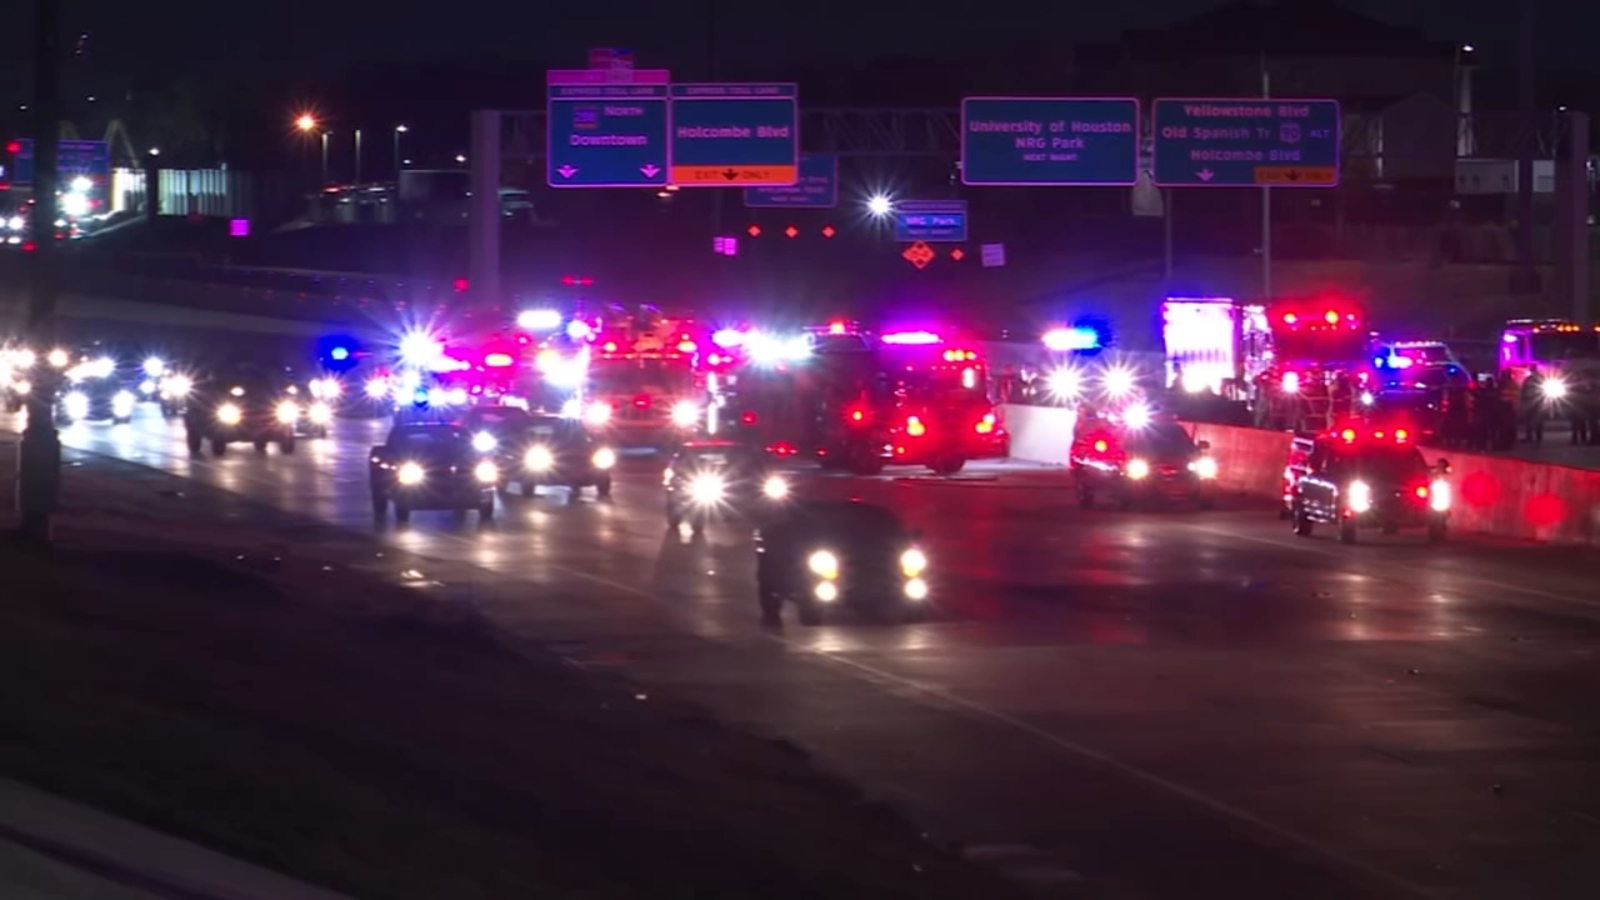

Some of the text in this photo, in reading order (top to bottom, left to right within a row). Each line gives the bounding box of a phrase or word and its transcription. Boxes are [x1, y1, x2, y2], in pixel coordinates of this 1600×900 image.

[1184, 105, 1310, 117] Yellowstone Blvd
[677, 126, 789, 138] Holcombe Blvd
[969, 120, 1131, 135] University of Houston
[1162, 127, 1187, 138] Old
[1193, 127, 1250, 140] Spanish
[1256, 128, 1271, 138] Tr
[1309, 129, 1330, 138] ALT
[569, 134, 648, 146] Downtown
[1015, 137, 1085, 149] NRG Park
[1190, 149, 1301, 160] Holcombe Blvd
[694, 170, 770, 180] EXIT ONLY
[933, 216, 957, 226] Park
